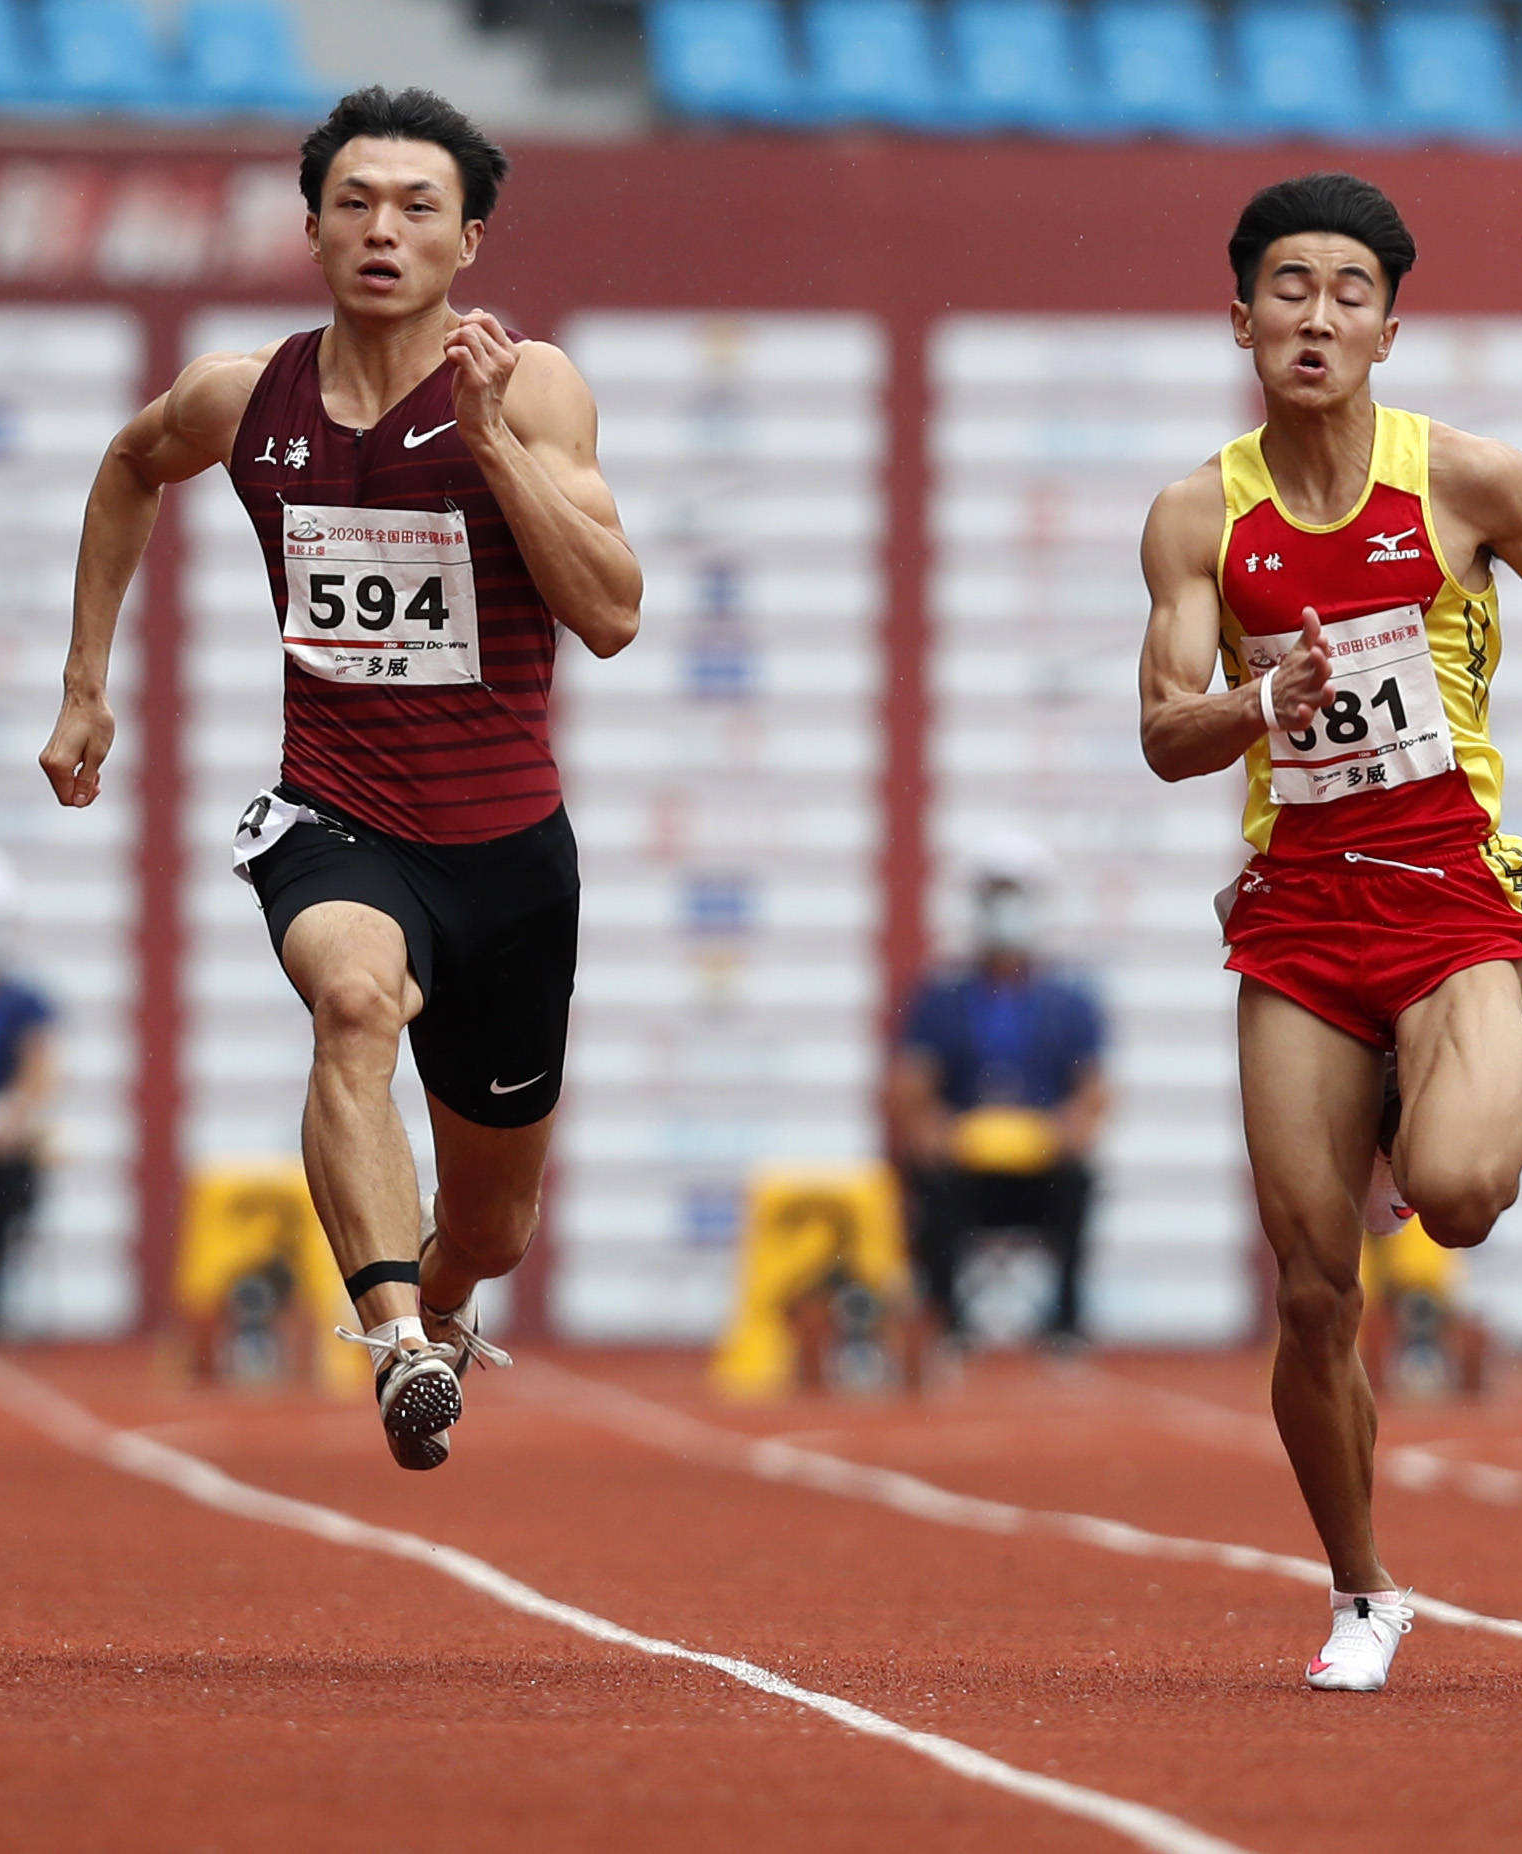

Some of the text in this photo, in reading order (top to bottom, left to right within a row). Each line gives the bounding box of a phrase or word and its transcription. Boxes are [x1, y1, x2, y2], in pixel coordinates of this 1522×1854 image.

[254, 436, 310, 469] 上海
[1245, 552, 1283, 573] 吉林
[309, 574, 449, 631] 594
[366, 656, 408, 677] 多威
[1347, 763, 1388, 787] 多威
